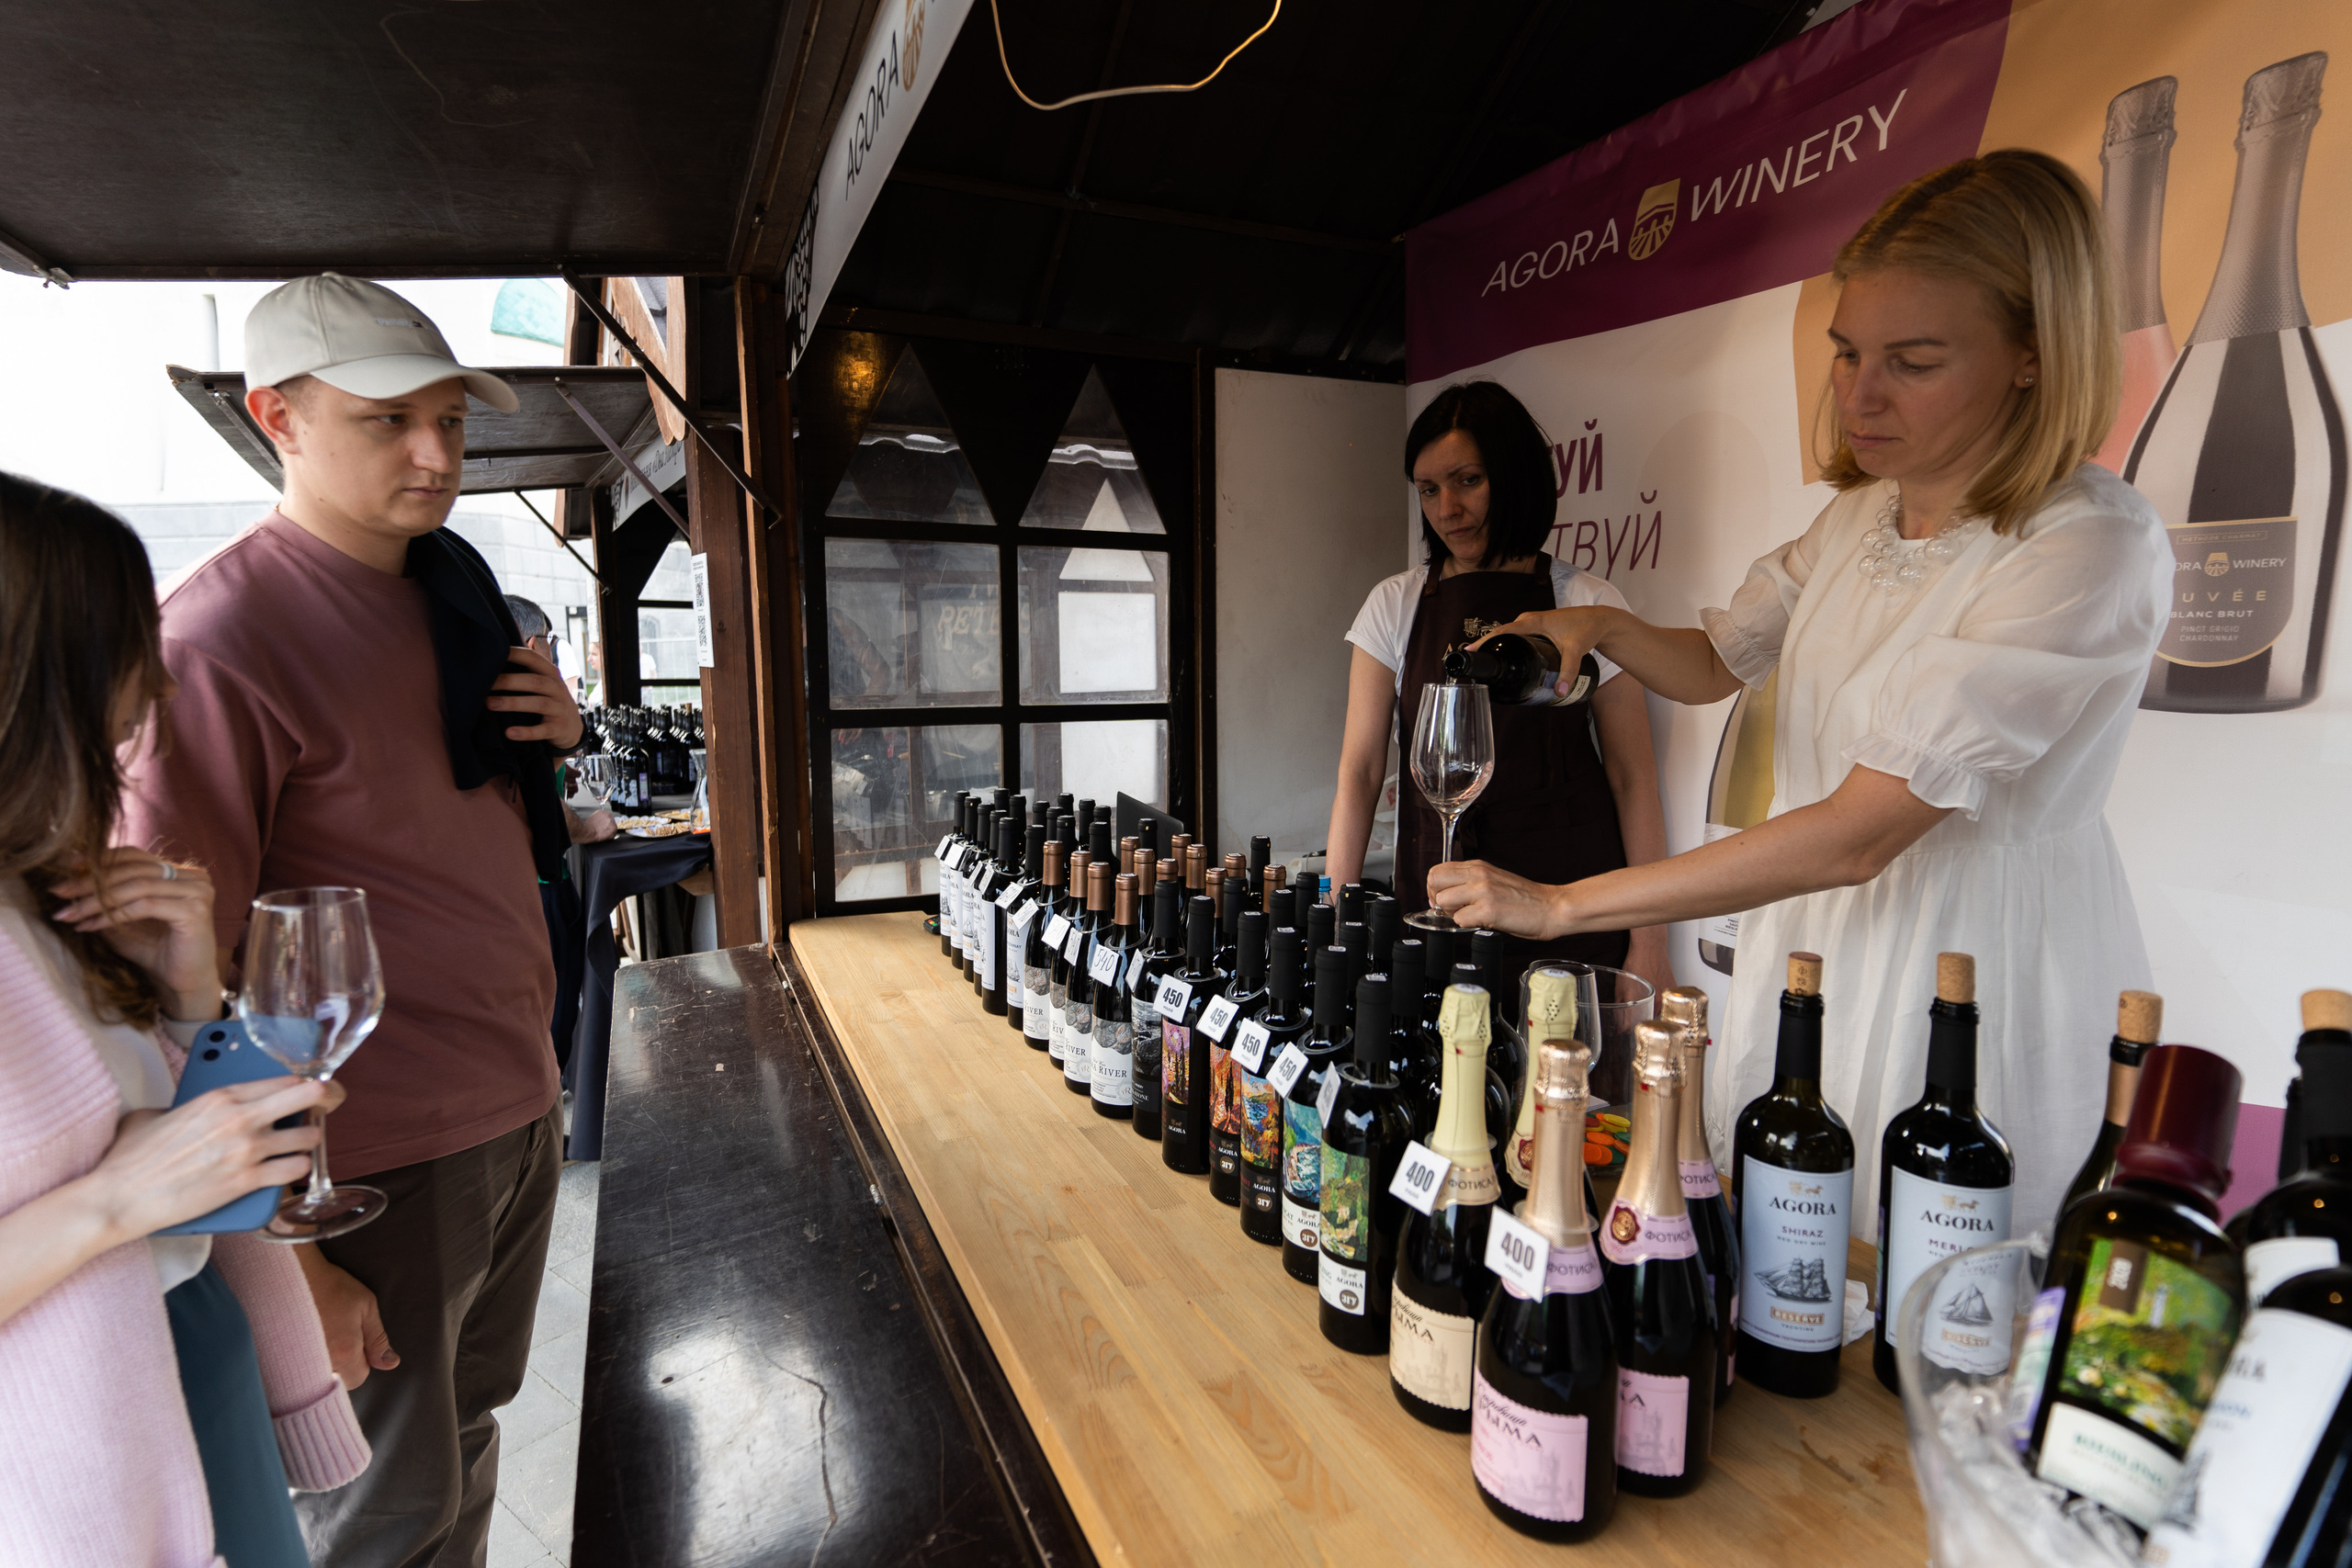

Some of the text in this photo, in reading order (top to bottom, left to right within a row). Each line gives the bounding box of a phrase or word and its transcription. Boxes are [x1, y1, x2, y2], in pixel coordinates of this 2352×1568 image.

[844, 29, 899, 201] AGORA
[1480, 88, 1909, 298] AGORA WINERY
[1549, 418, 1603, 500] УЙ
[2233, 558, 2288, 569] WINERY
[2182, 589, 2267, 603] UVÉE
[937, 602, 1031, 636] PETES
[2170, 609, 2255, 619] BLANC BRUT
[2180, 625, 2240, 633] PINOT GRIGIO
[2179, 634, 2240, 642] CHARDONNAY
[1093, 948, 1115, 973] 540
[1162, 987, 1184, 1009] 450
[1209, 1007, 1229, 1028] 450
[1066, 1043, 1086, 1056] RIVER
[1241, 1032, 1261, 1056] 450
[1099, 1066, 1128, 1078] RIVER
[1278, 1056, 1298, 1082] 450
[1168, 1125, 1186, 1134] AGORA
[1217, 1146, 1238, 1157] AGORA
[1221, 1160, 1234, 1170] ЗГУ
[1406, 1161, 1435, 1192] 400
[1252, 1182, 1276, 1193] AGORA
[1257, 1197, 1271, 1207] ЗГУ
[1769, 1196, 1838, 1216] AGORA
[1296, 1216, 1321, 1229] AGORA
[1920, 1210, 1996, 1233] AGORA
[1302, 1233, 1317, 1244] ЗГУ
[1781, 1225, 1825, 1239] SHIRAZ
[1500, 1231, 1535, 1271] 400
[1335, 1276, 1364, 1290] AGORA
[1341, 1294, 1358, 1306] ЗГУ
[1773, 1311, 1822, 1325] RESERVE
